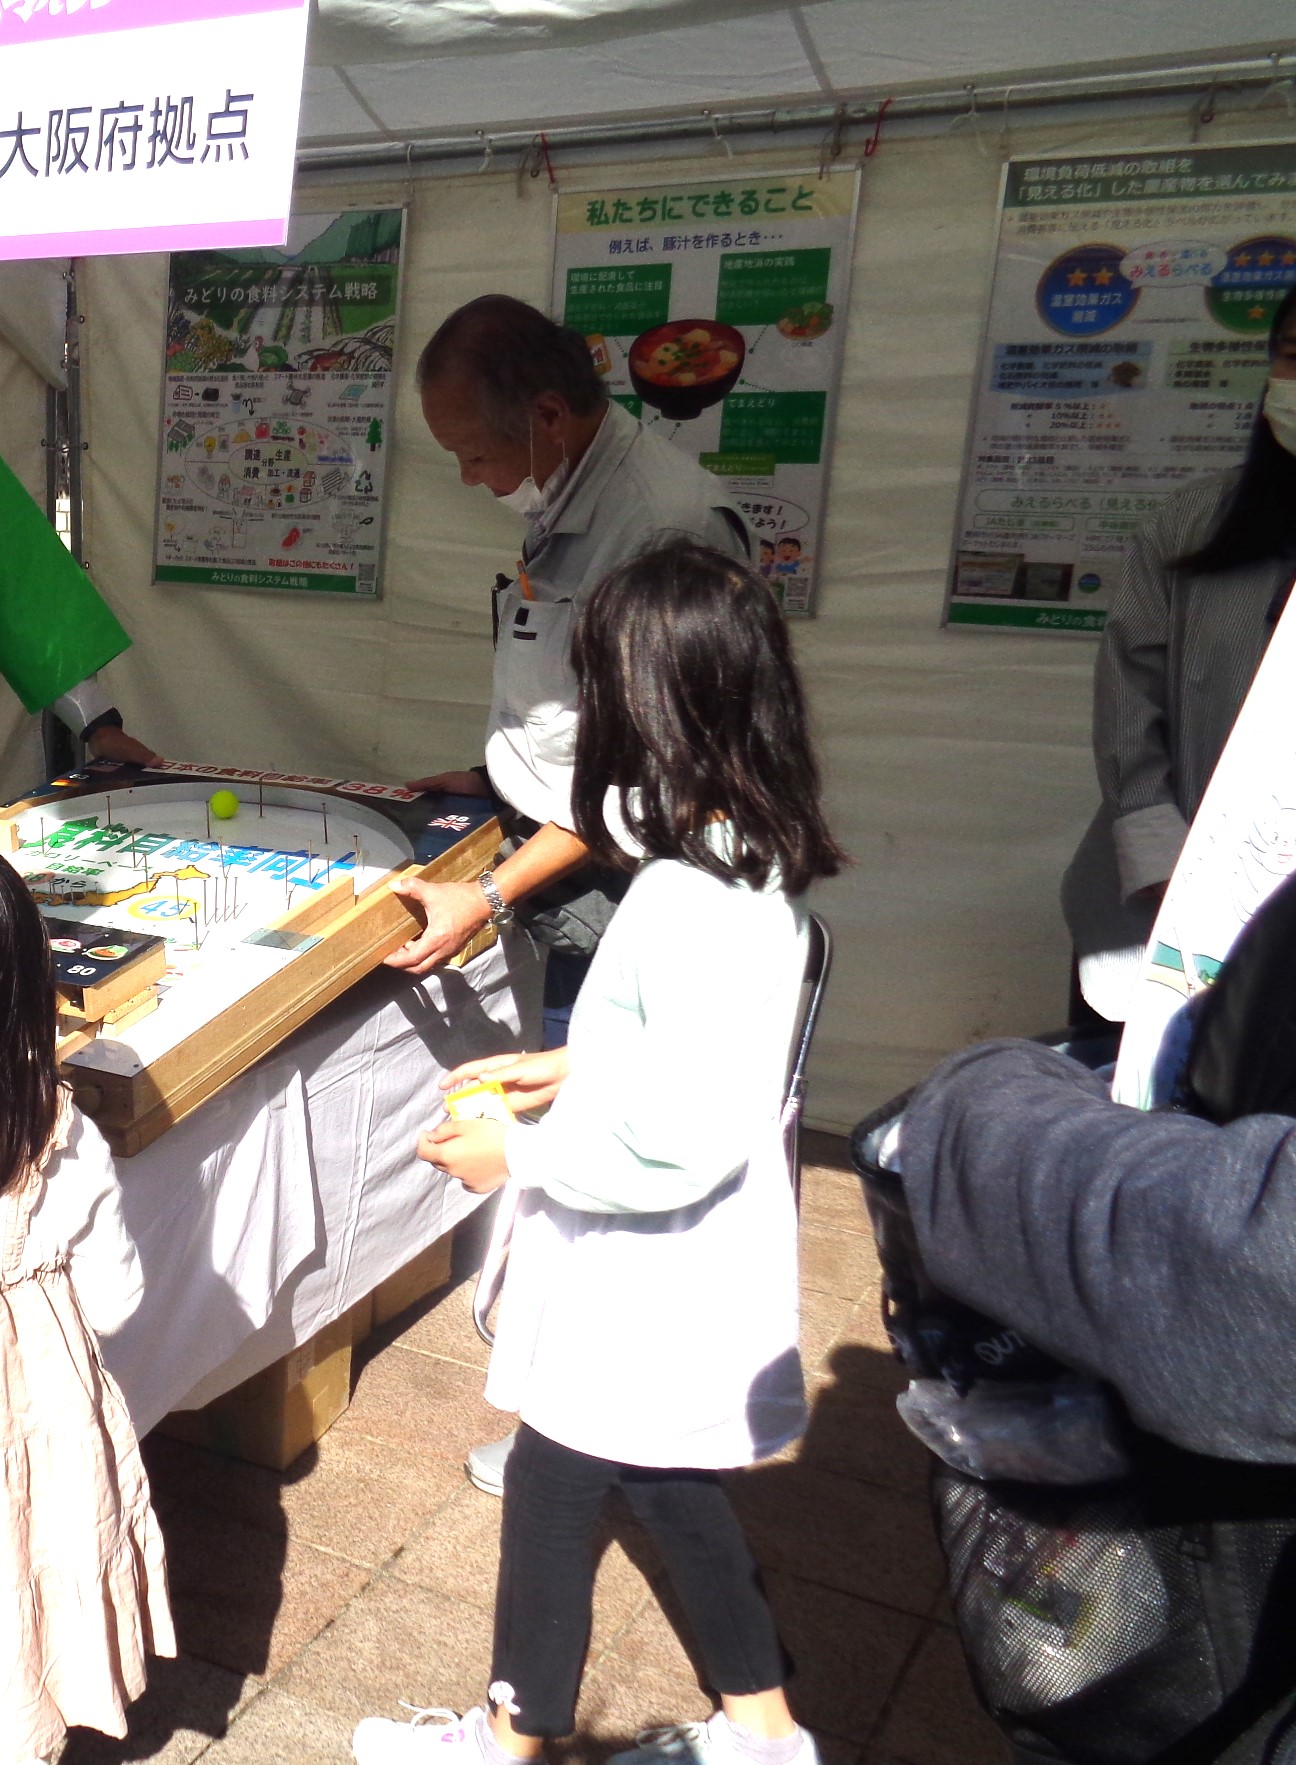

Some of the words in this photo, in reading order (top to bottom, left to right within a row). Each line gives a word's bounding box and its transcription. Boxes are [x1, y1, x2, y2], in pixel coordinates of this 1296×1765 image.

[586, 184, 815, 227] 私たちにできること
[184, 281, 379, 303] みどりの食料システム戦略
[735, 501, 783, 516] きます！
[211, 572, 308, 588] みどりの食料システム戦略
[18, 815, 357, 891] 食料自給率向上
[139, 900, 191, 918] 45
[67, 964, 97, 978] 80
